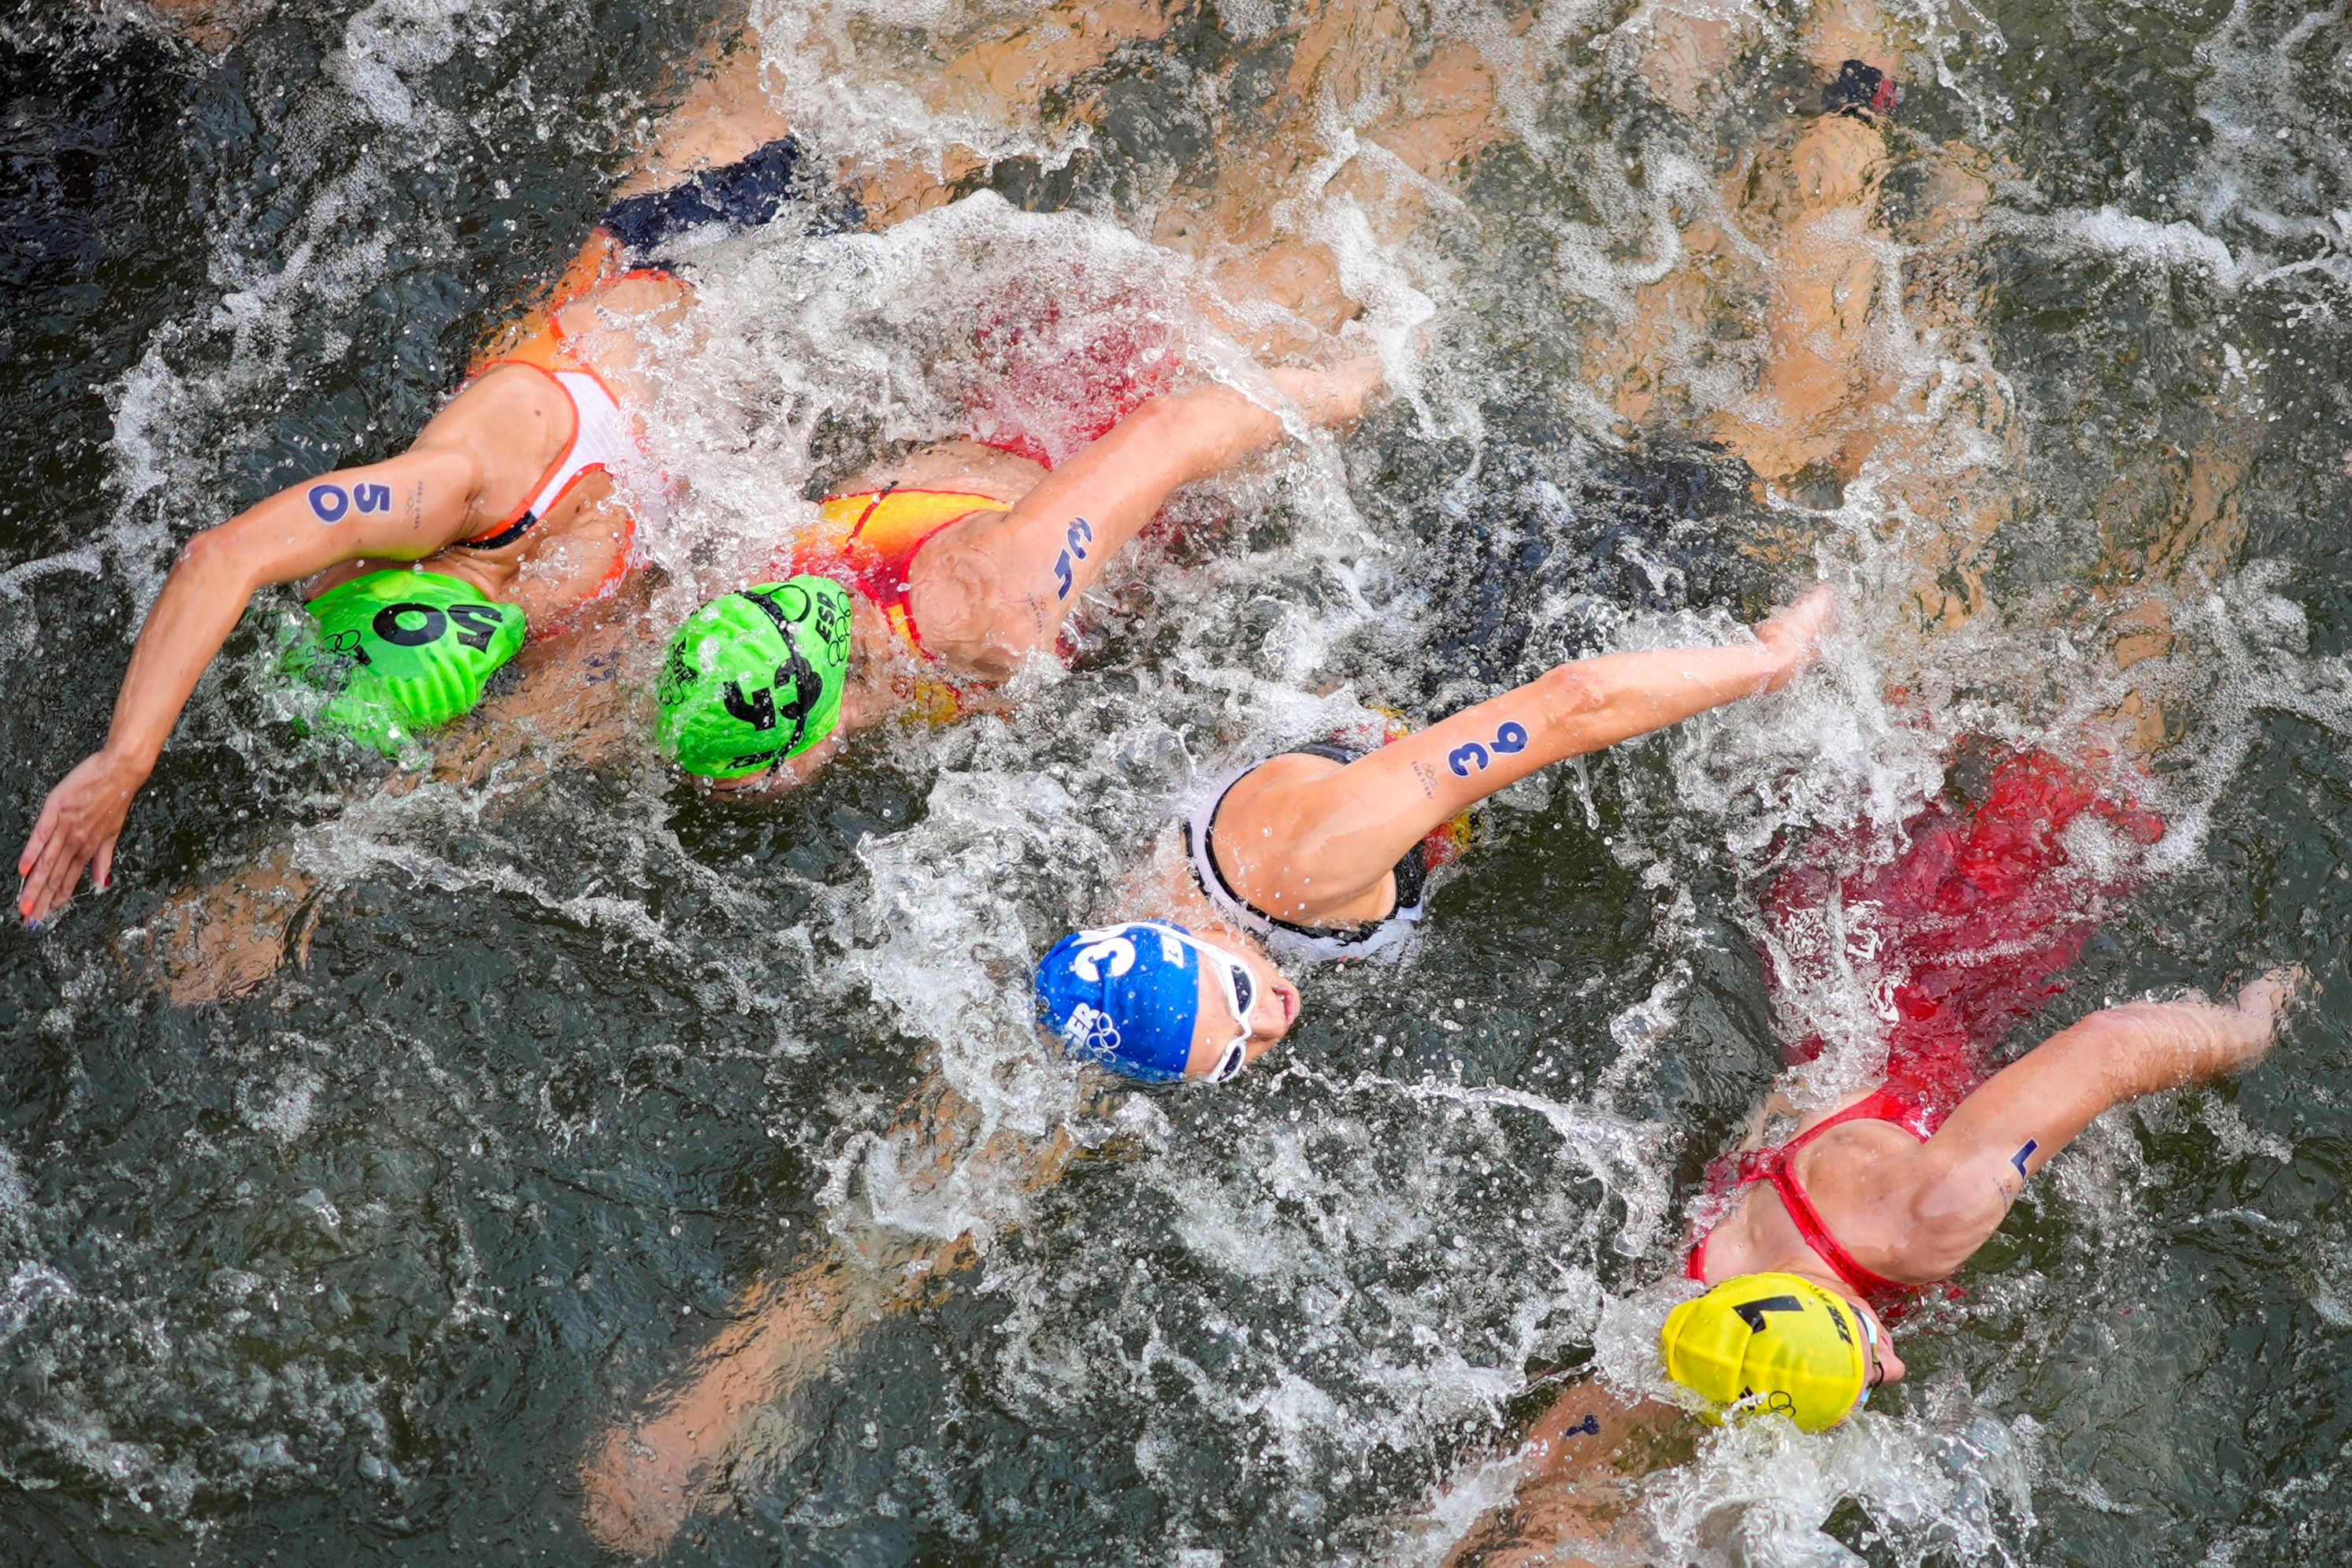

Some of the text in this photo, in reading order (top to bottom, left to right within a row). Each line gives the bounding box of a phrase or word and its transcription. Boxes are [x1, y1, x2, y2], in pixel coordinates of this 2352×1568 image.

[307, 481, 392, 525] 50
[372, 602, 504, 654] 50
[1447, 720, 1529, 777] 36
[1733, 1296, 1805, 1334] 1
